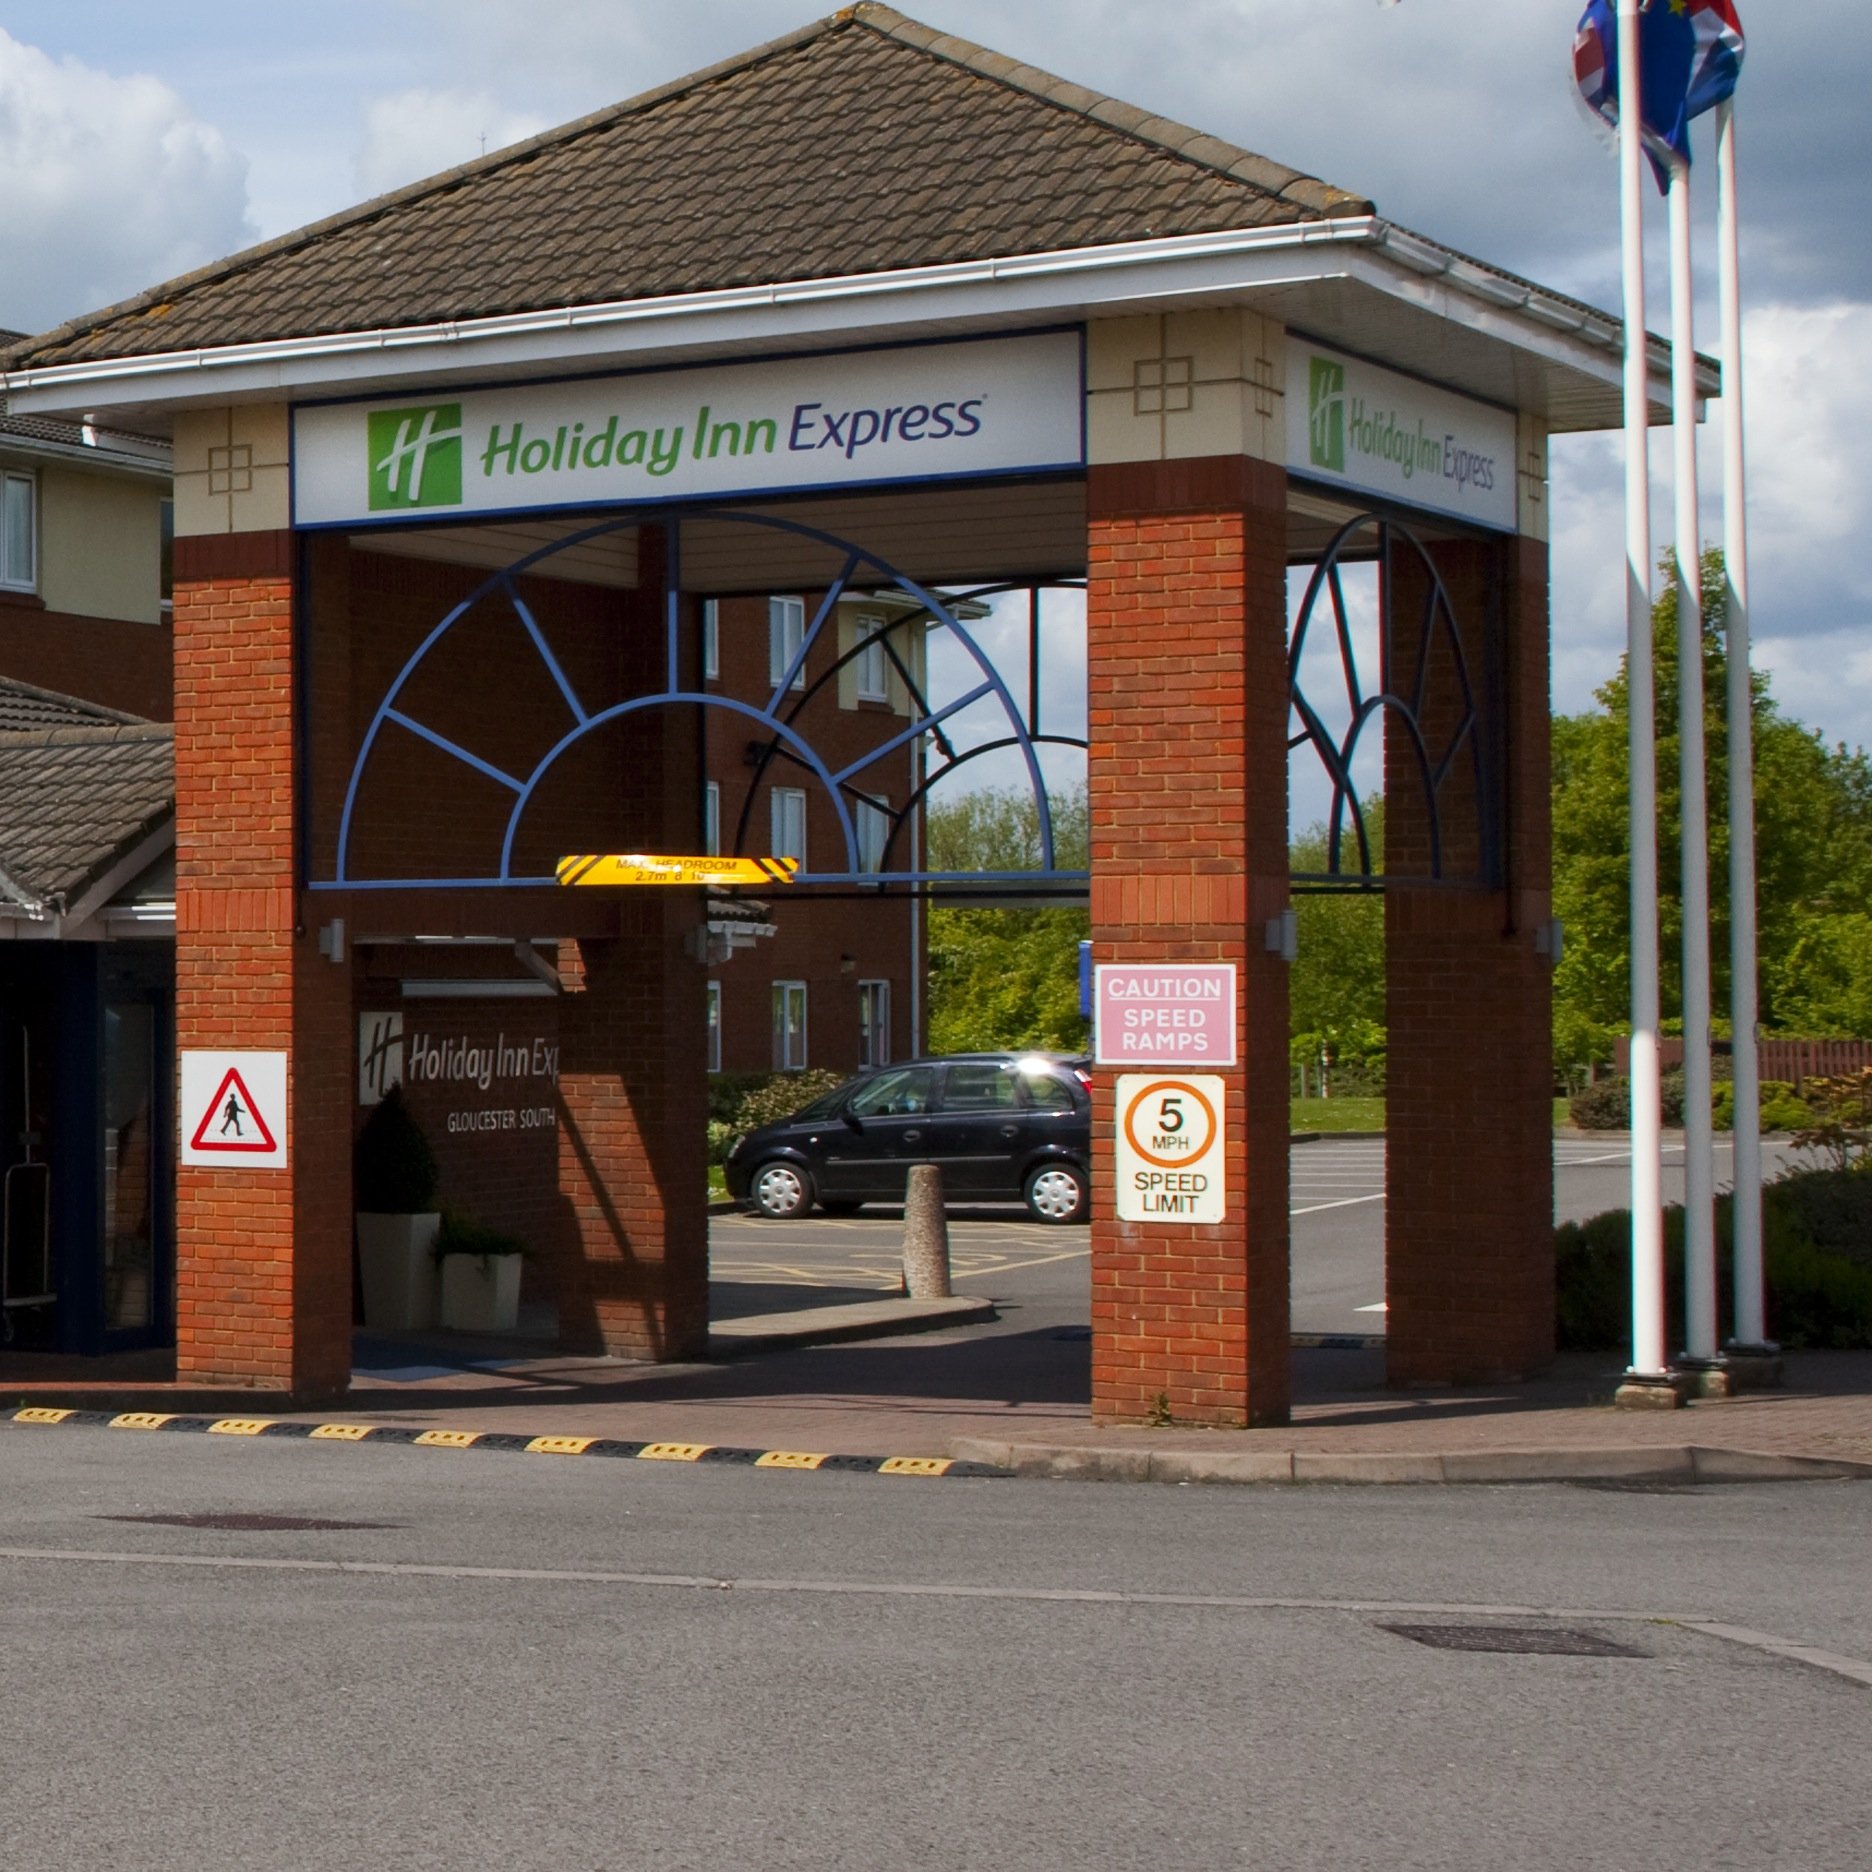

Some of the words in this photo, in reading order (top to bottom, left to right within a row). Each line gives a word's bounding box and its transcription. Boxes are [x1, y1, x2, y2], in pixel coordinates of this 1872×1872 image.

[480, 415, 680, 477] Holiday
[691, 406, 778, 460] Inn
[789, 398, 983, 459] Express
[1349, 397, 1414, 479] Holiday
[1416, 419, 1441, 474] Inn
[1443, 434, 1494, 492] Express
[656, 859, 737, 870] HEADROOM
[636, 871, 667, 881] 2.7m
[1108, 978, 1221, 998] CAUTION
[1124, 1009, 1206, 1027] SPEED
[1122, 1032, 1208, 1051] RAMPS
[409, 1033, 494, 1090] Holiday
[496, 1032, 528, 1077] Inn
[448, 1110, 515, 1132] GLOUCESTER
[519, 1107, 555, 1128] SOUTH
[1158, 1098, 1184, 1132] 5
[1152, 1135, 1189, 1149] MPH
[1135, 1172, 1208, 1192] SPEED
[1143, 1194, 1199, 1213] LIMIT
